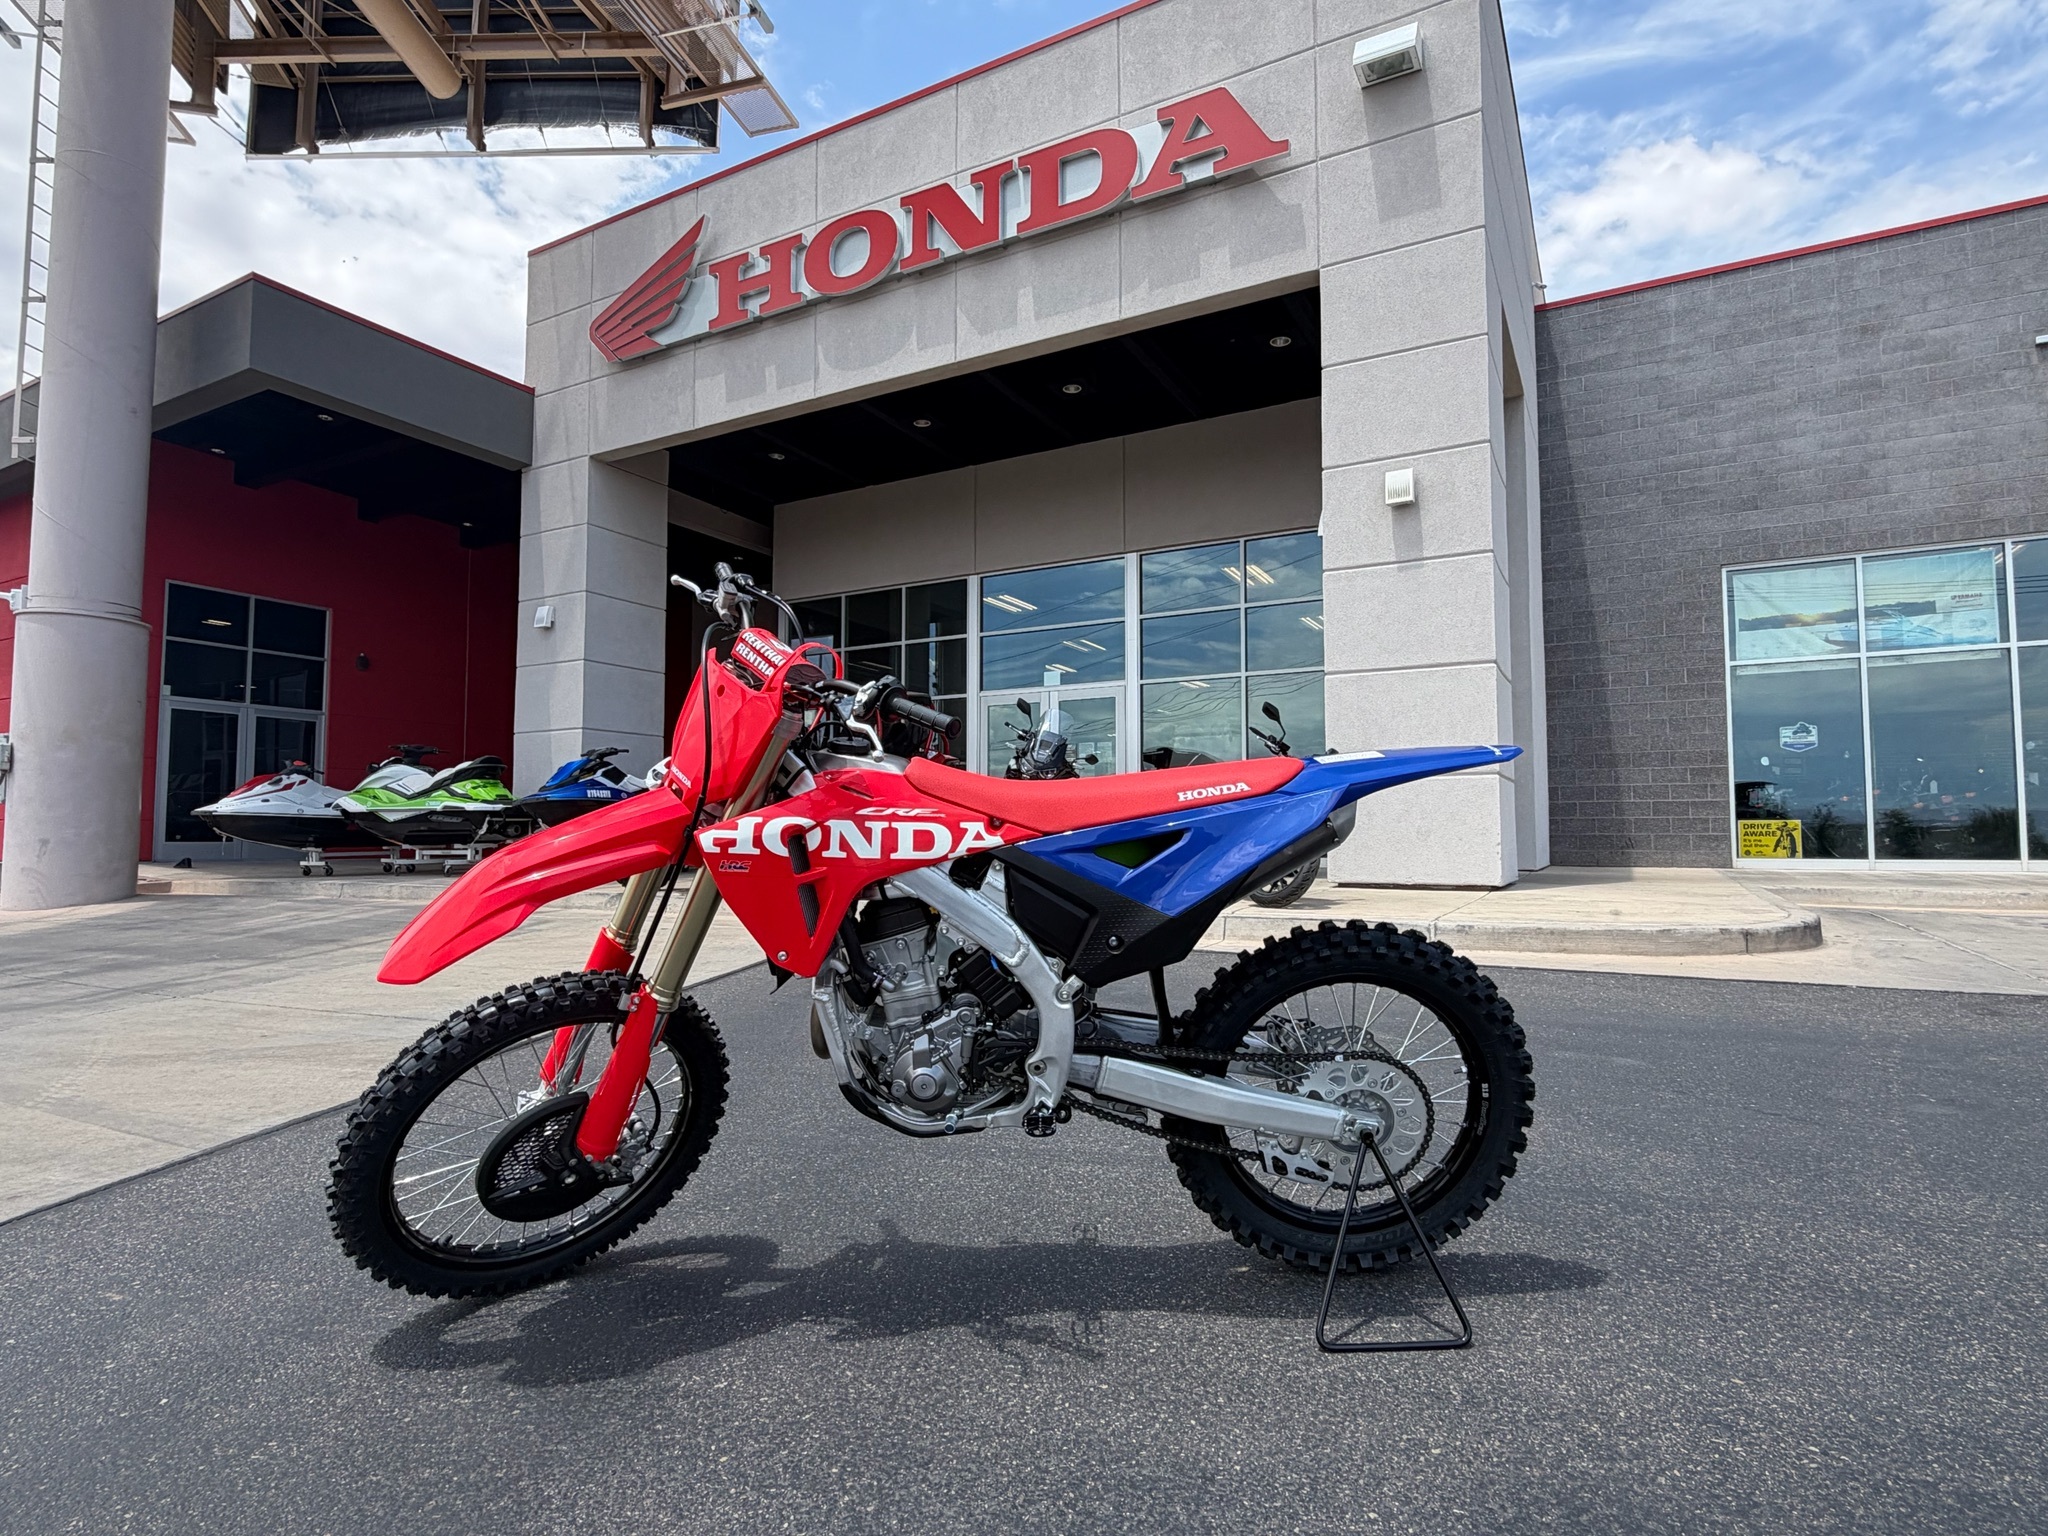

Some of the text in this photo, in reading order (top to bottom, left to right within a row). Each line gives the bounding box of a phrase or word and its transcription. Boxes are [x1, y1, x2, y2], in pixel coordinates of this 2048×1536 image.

[708, 87, 1289, 332] HONDA
[735, 642, 775, 677] RENTHA
[670, 763, 692, 789] HONDA
[1177, 782, 1251, 802] HONDA
[855, 806, 939, 817] CRF
[699, 816, 1005, 861] HONDA
[718, 860, 752, 873] HRC
